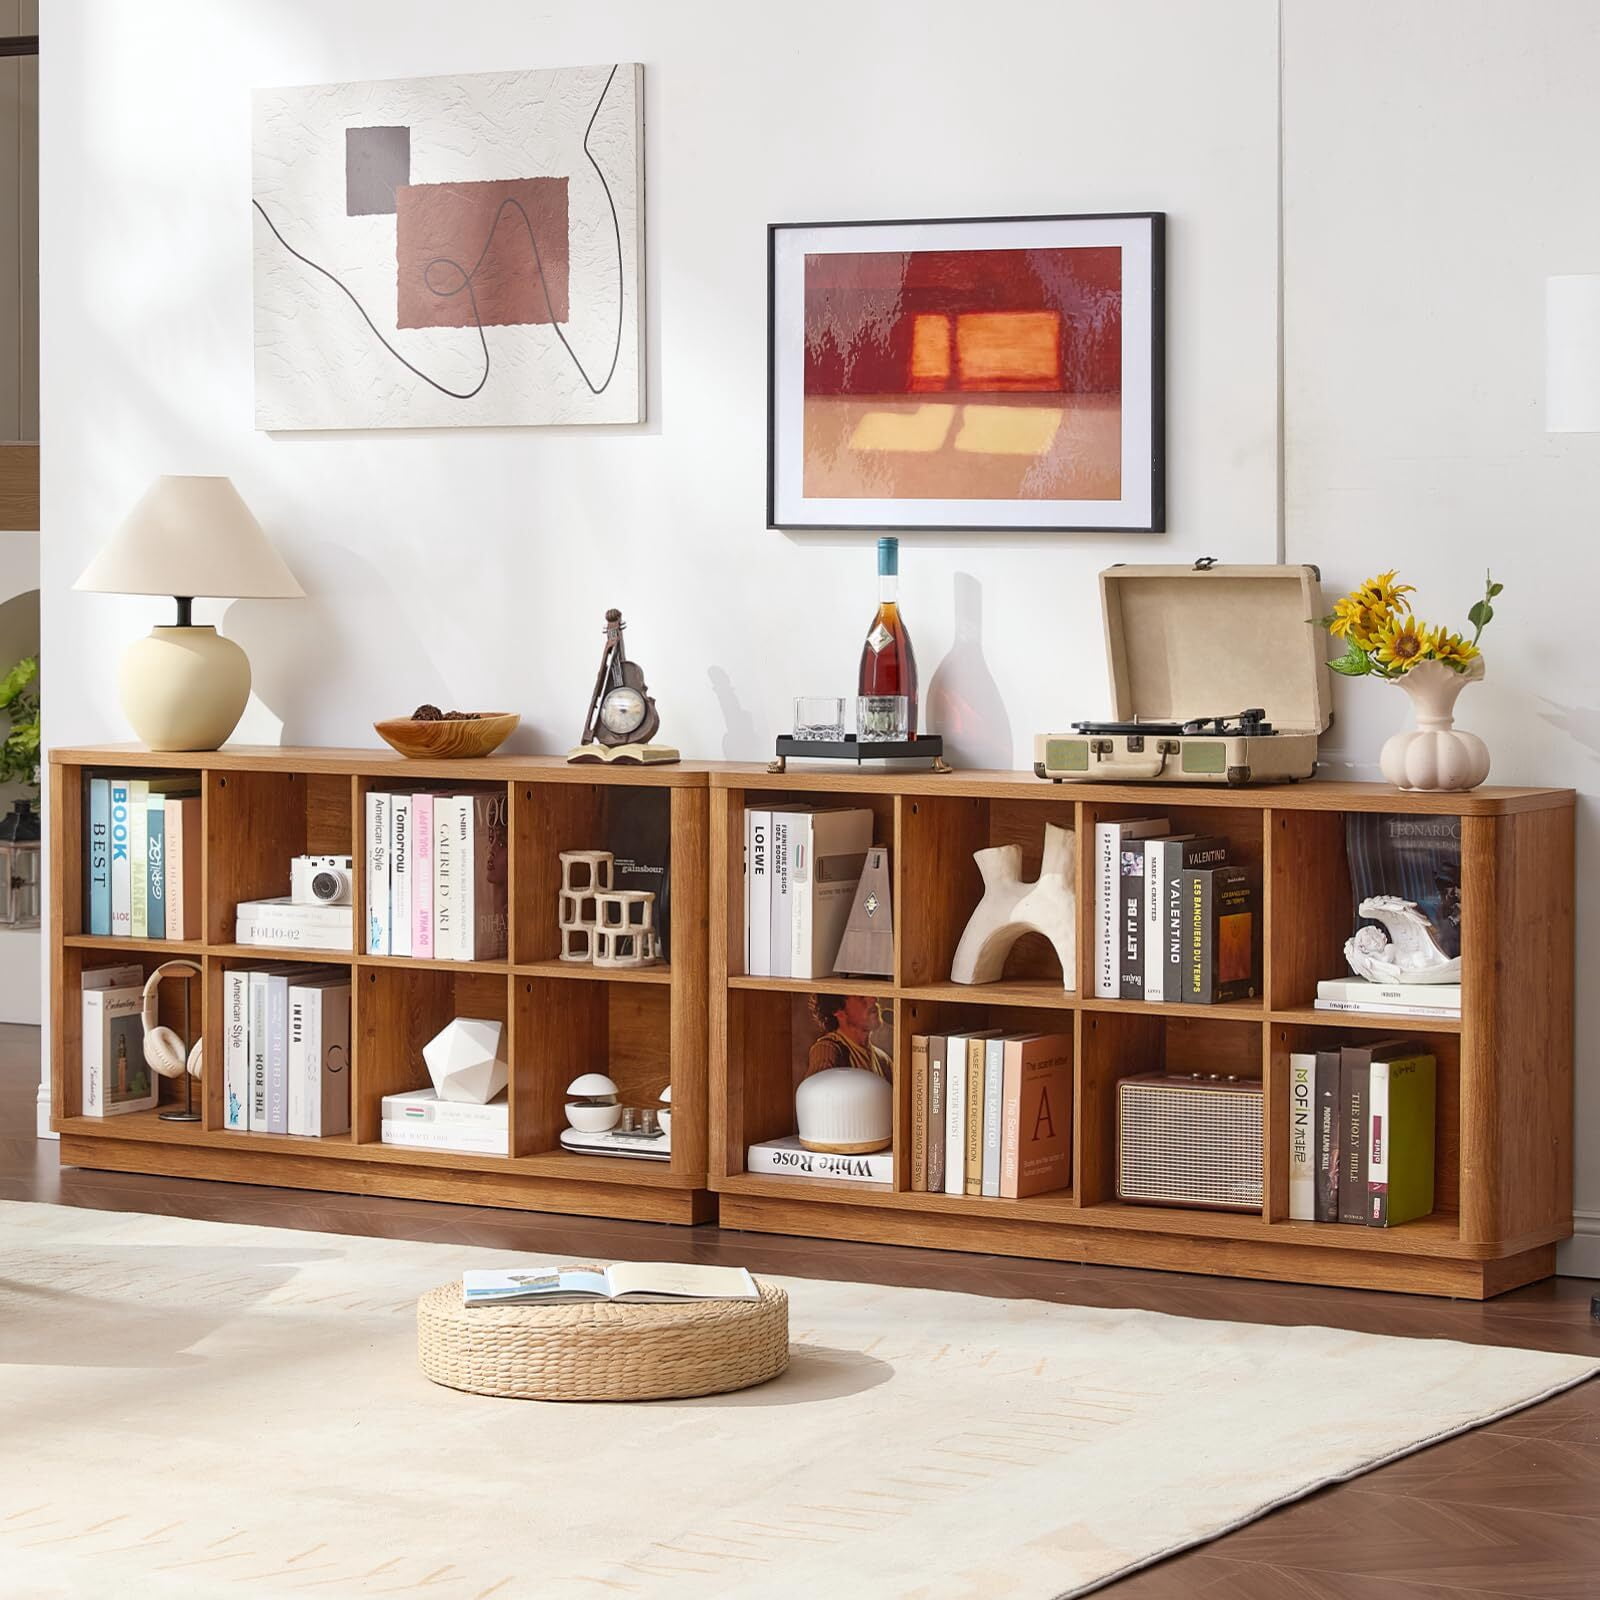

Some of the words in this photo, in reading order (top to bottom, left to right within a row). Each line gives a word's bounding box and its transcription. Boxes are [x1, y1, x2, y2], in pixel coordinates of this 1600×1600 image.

[112, 788, 127, 861] BOOK
[375, 799, 385, 844] American
[418, 810, 429, 835] HAPPY
[396, 806, 408, 873] Tomorrow
[755, 825, 765, 876] LOEWE
[93, 824, 106, 888] BEST
[373, 847, 384, 871] Style
[1189, 849, 1226, 865] VALENTINO
[1193, 879, 1201, 895] LES
[419, 910, 429, 932] WHAT
[1128, 898, 1138, 917] BE
[1170, 878, 1181, 963] VALENTINO
[1128, 920, 1138, 933] IT
[1193, 897, 1202, 948] BANQUIERS
[419, 934, 429, 945] DO
[1128, 937, 1138, 960] LET
[1193, 949, 1201, 962] DU
[1193, 963, 1201, 993] TEMPS
[233, 978, 243, 1022] American
[231, 1025, 243, 1048] Style
[293, 1004, 302, 1042] INEDIA
[256, 1054, 264, 1087] ROOM
[256, 1091, 264, 1113] THE
[1031, 1086, 1056, 1141] A
[1351, 1092, 1360, 1115] THE
[970, 1107, 978, 1161] DECORATION
[1351, 1118, 1360, 1147] HOLY
[772, 1151, 814, 1172] Rose
[819, 1156, 873, 1178] White
[1350, 1152, 1359, 1183] BIBLE
